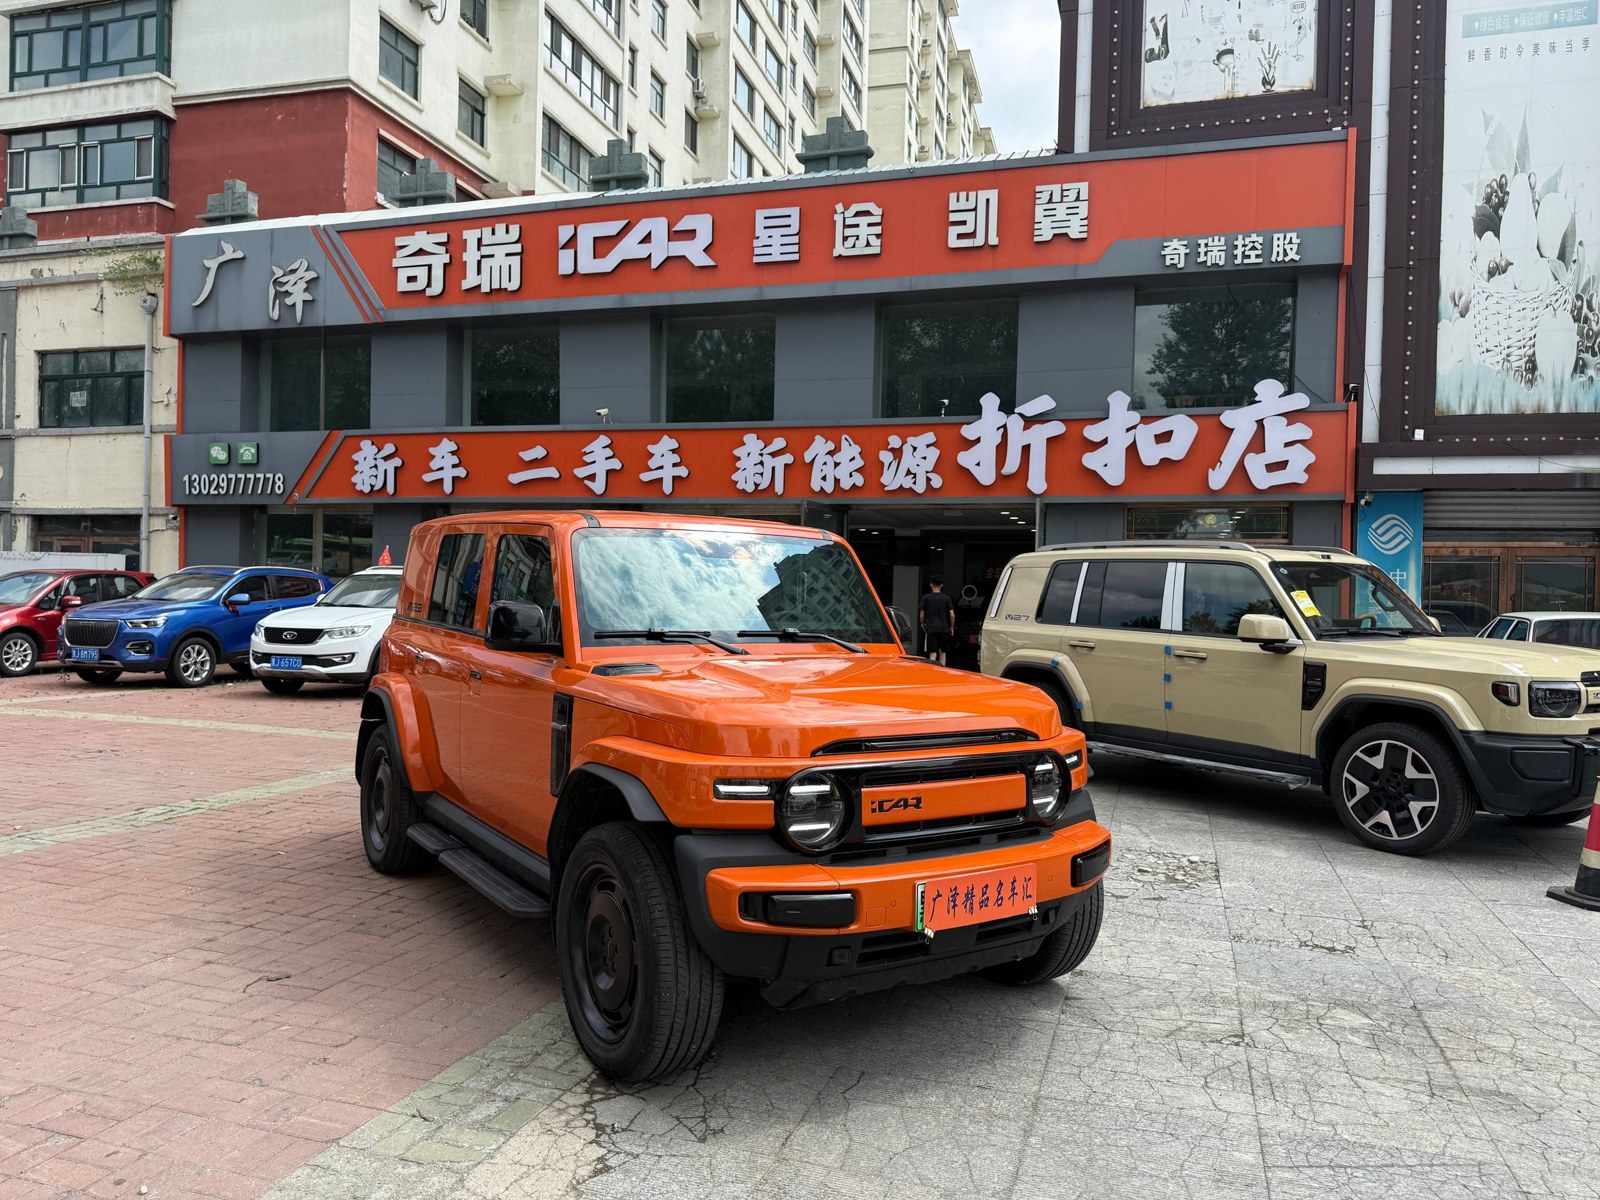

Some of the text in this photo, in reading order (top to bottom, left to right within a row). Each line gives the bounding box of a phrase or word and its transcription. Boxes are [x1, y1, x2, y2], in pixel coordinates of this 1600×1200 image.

[1479, 14, 1511, 32] 绿色食品
[1467, 36, 1591, 63] 鲜香时令美味当季
[392, 223, 522, 297] 奇瑞
[753, 202, 883, 263] 星途
[947, 181, 1089, 249] 凯翼
[1160, 232, 1302, 270] 奇瑞控股
[191, 240, 320, 324] 广泽
[351, 378, 1316, 496] 新车 二手车 新能源 折扣店
[182, 472, 285, 496] 13029777778
[928, 874, 1033, 923] 广泽精品名车汇
